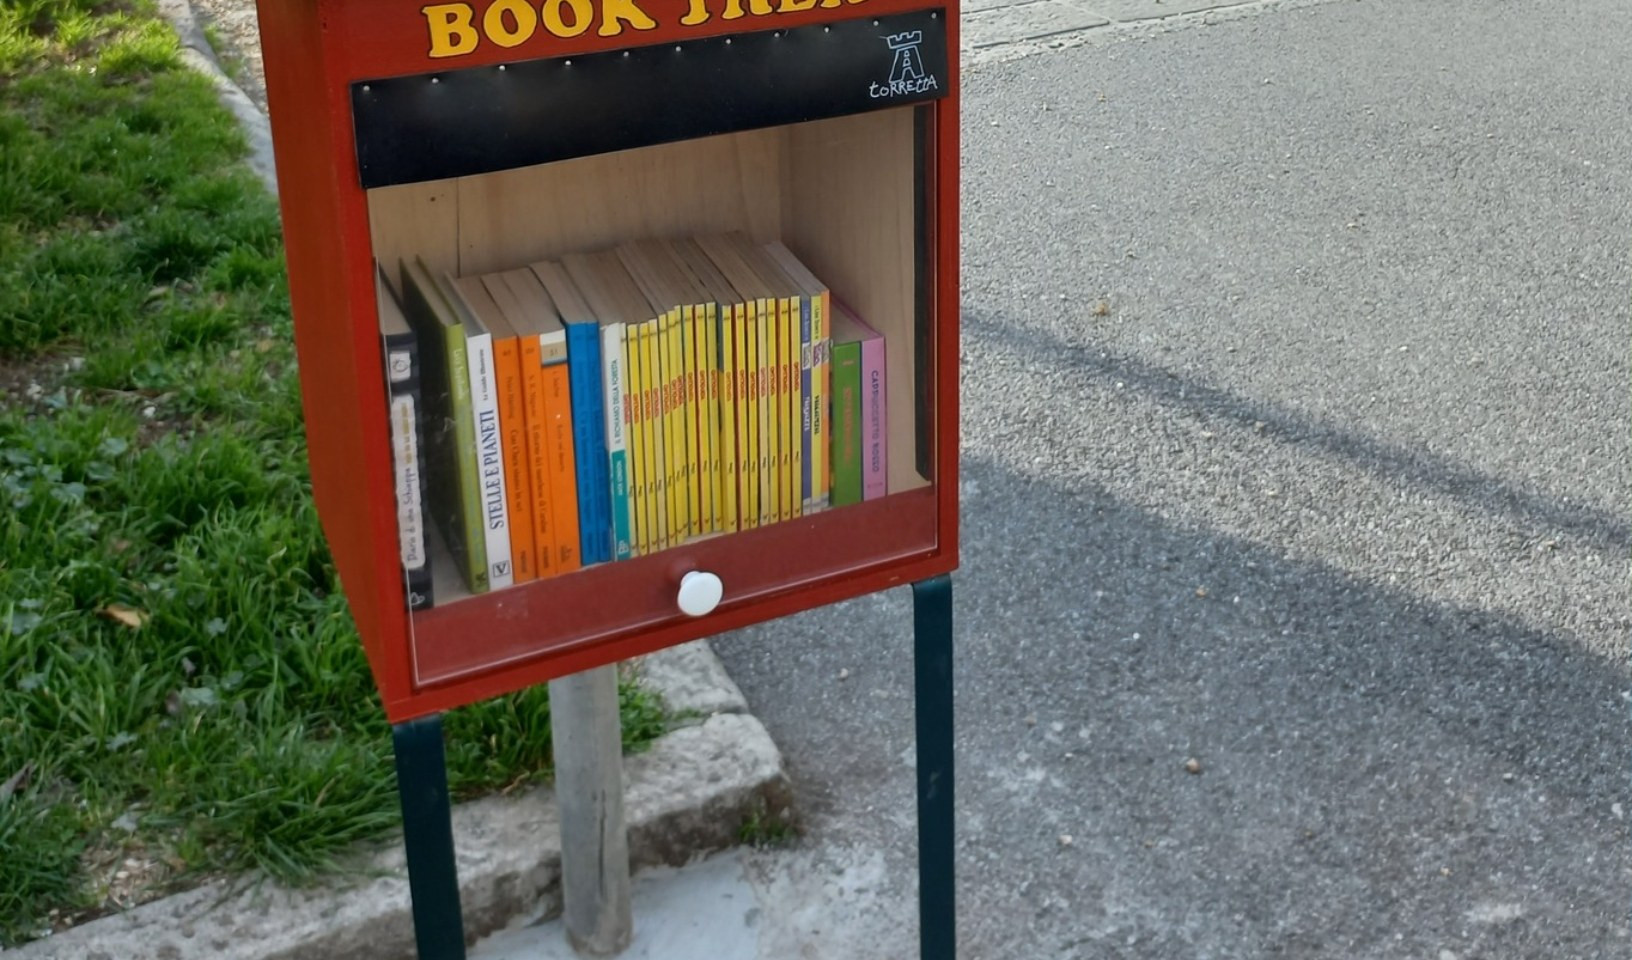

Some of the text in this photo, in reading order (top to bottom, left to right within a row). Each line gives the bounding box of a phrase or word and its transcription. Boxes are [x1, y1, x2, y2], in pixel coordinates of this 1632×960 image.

[479, 409, 505, 530] STELLE E PIANETI
